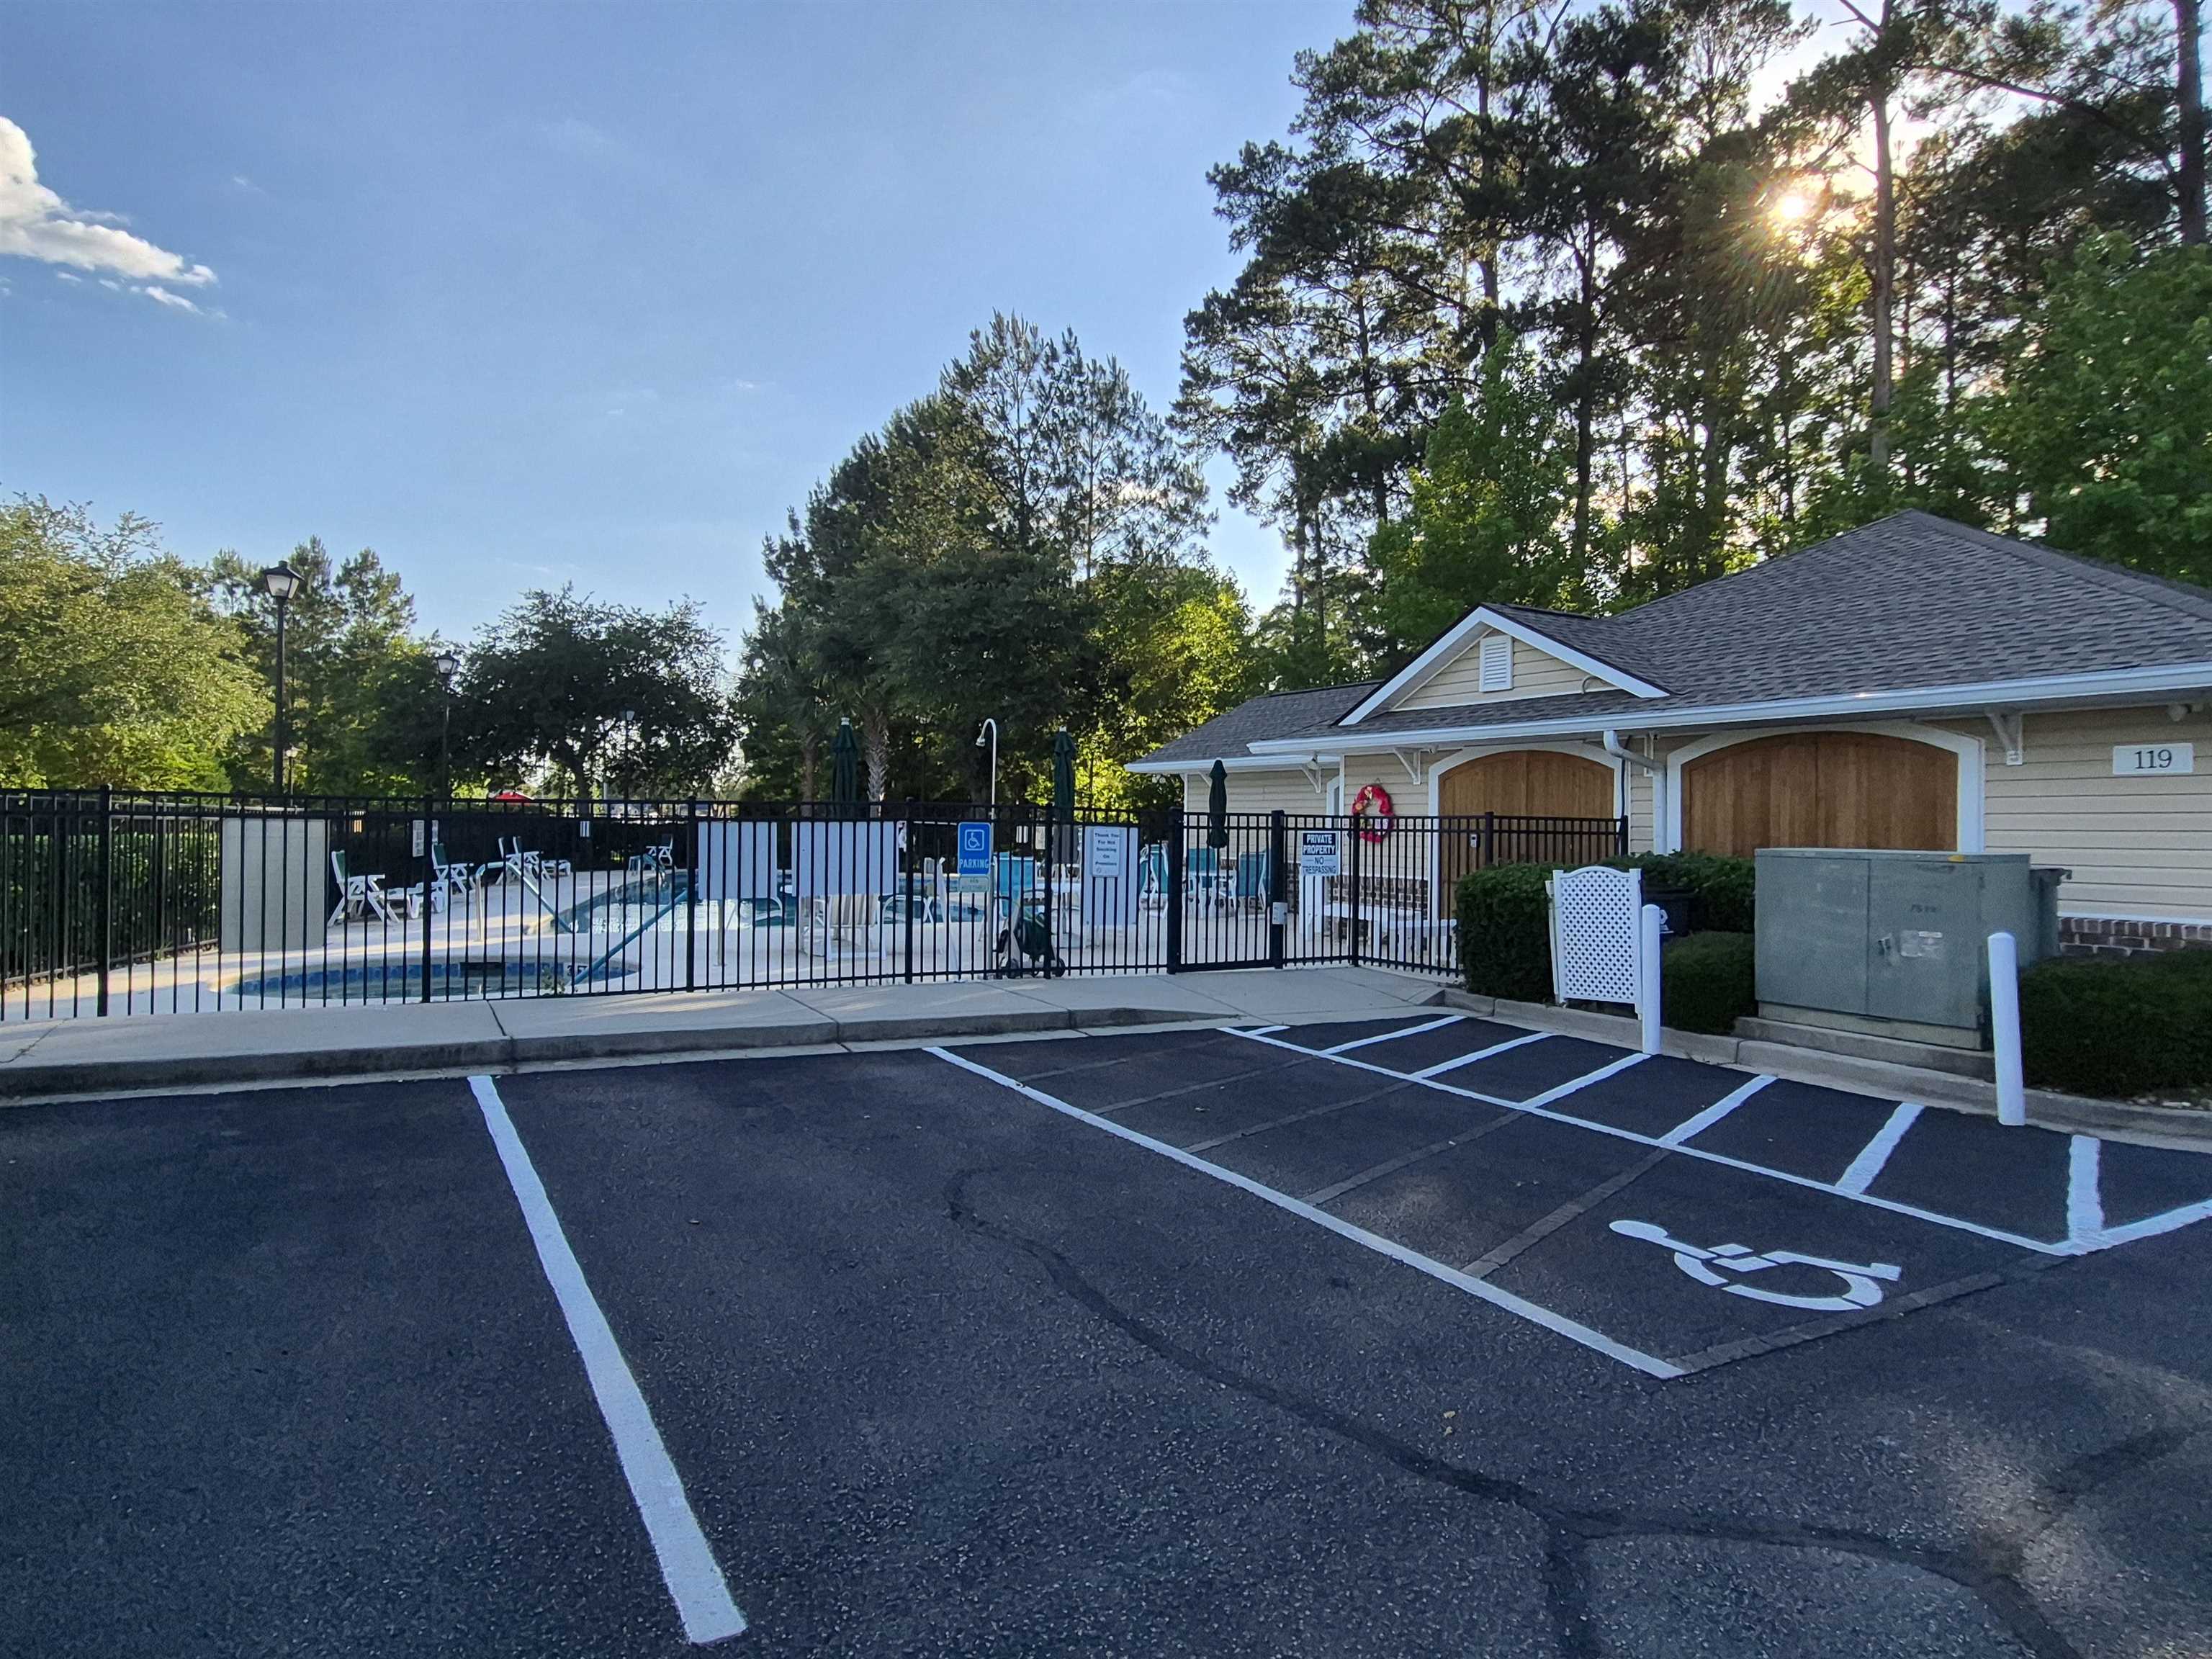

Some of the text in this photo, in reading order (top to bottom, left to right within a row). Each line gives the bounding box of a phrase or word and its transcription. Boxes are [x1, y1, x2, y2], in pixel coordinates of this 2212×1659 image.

[2134, 749, 2172, 769] 119
[1307, 834, 1332, 844] PRIVATE
[1303, 845, 1336, 855] PROPERTY
[959, 858, 989, 869] PARKING
[1302, 866, 1336, 874] TRESPASSING
